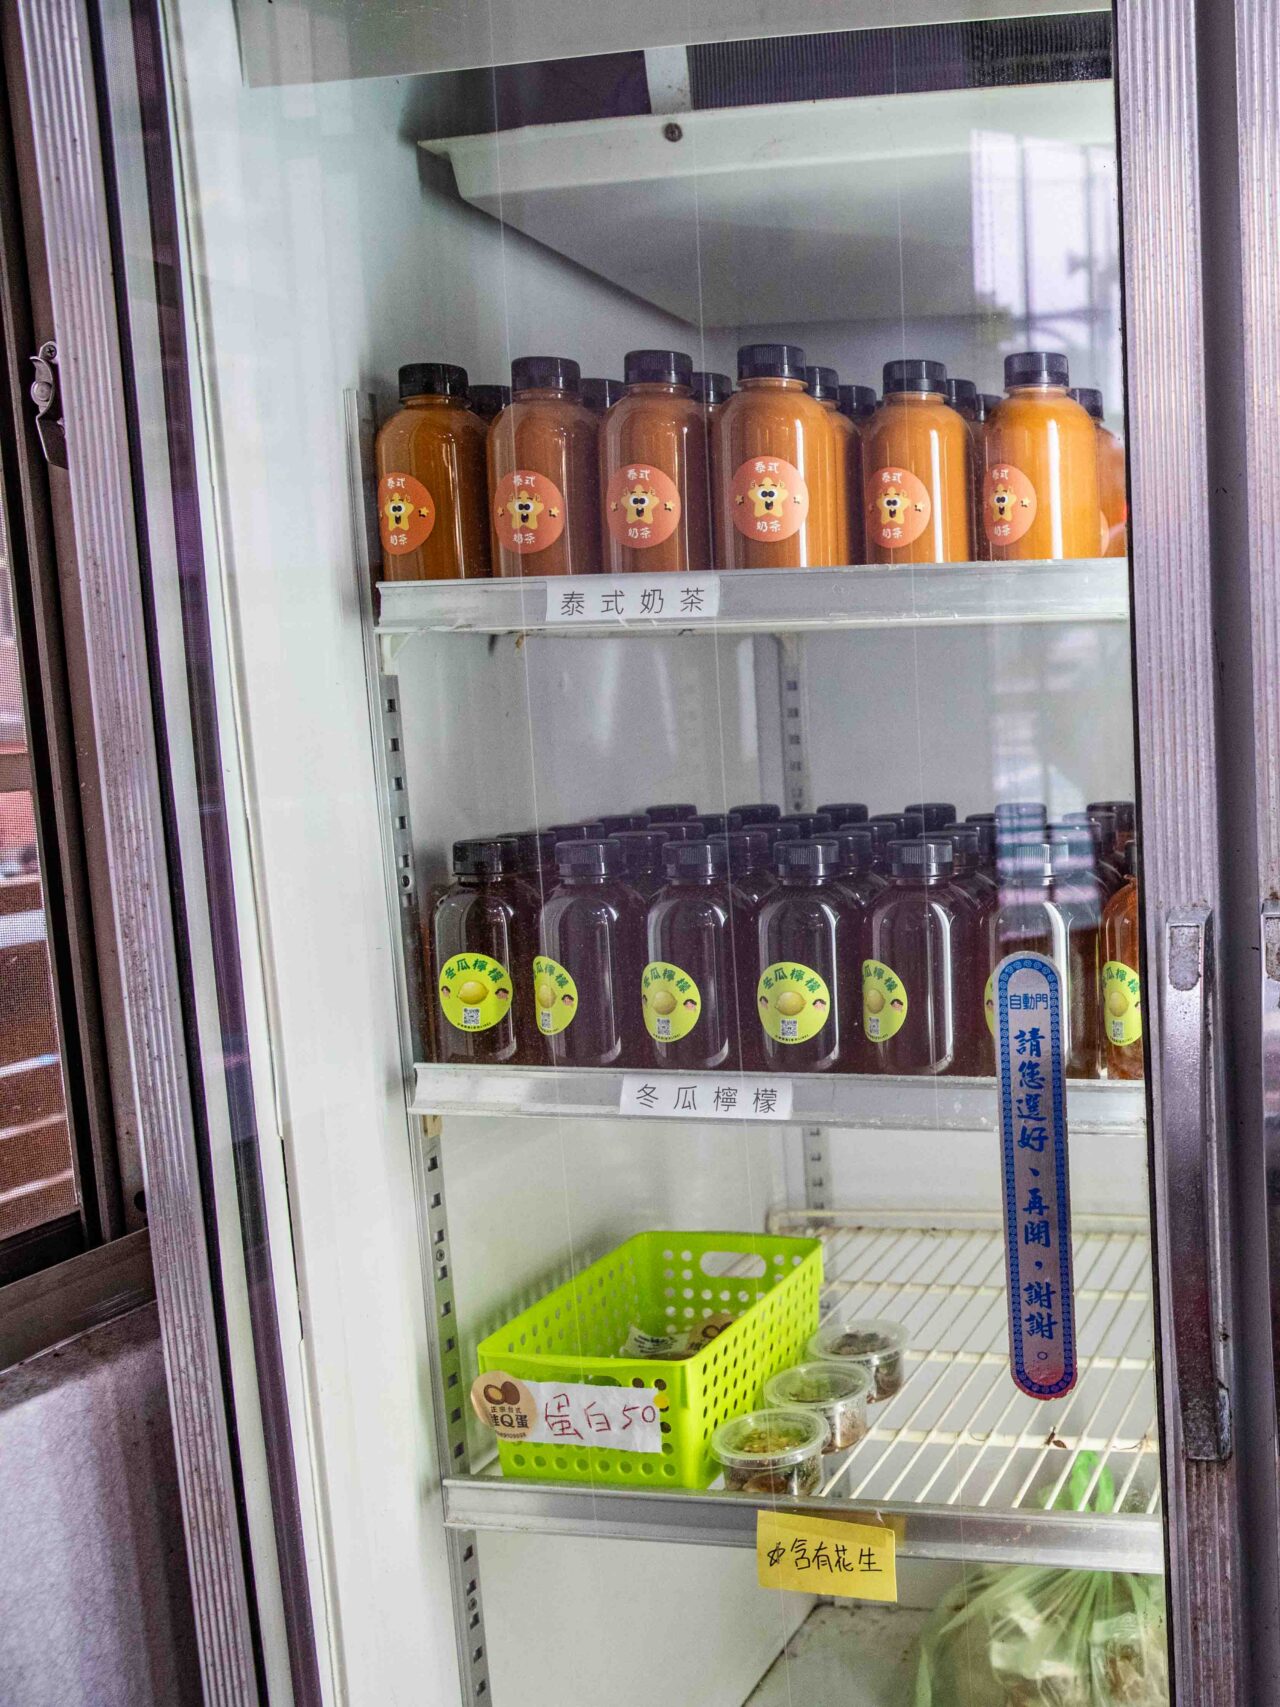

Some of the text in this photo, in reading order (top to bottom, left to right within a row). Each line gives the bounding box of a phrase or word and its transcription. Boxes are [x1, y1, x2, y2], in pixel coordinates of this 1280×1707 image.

[753, 461, 781, 475] 泰式
[627, 526, 652, 540] 奶茶
[755, 520, 782, 534] 奶茶
[560, 586, 706, 617] 泰式奶茶
[445, 958, 504, 983] 冬瓜檸檬
[535, 961, 569, 989] 瓜檸檬
[763, 967, 821, 993] 冬瓜檸檬
[864, 964, 899, 993] 瓜檸檬
[1009, 993, 1049, 1010] 自動門
[636, 1083, 778, 1114] 冬瓜檸檬
